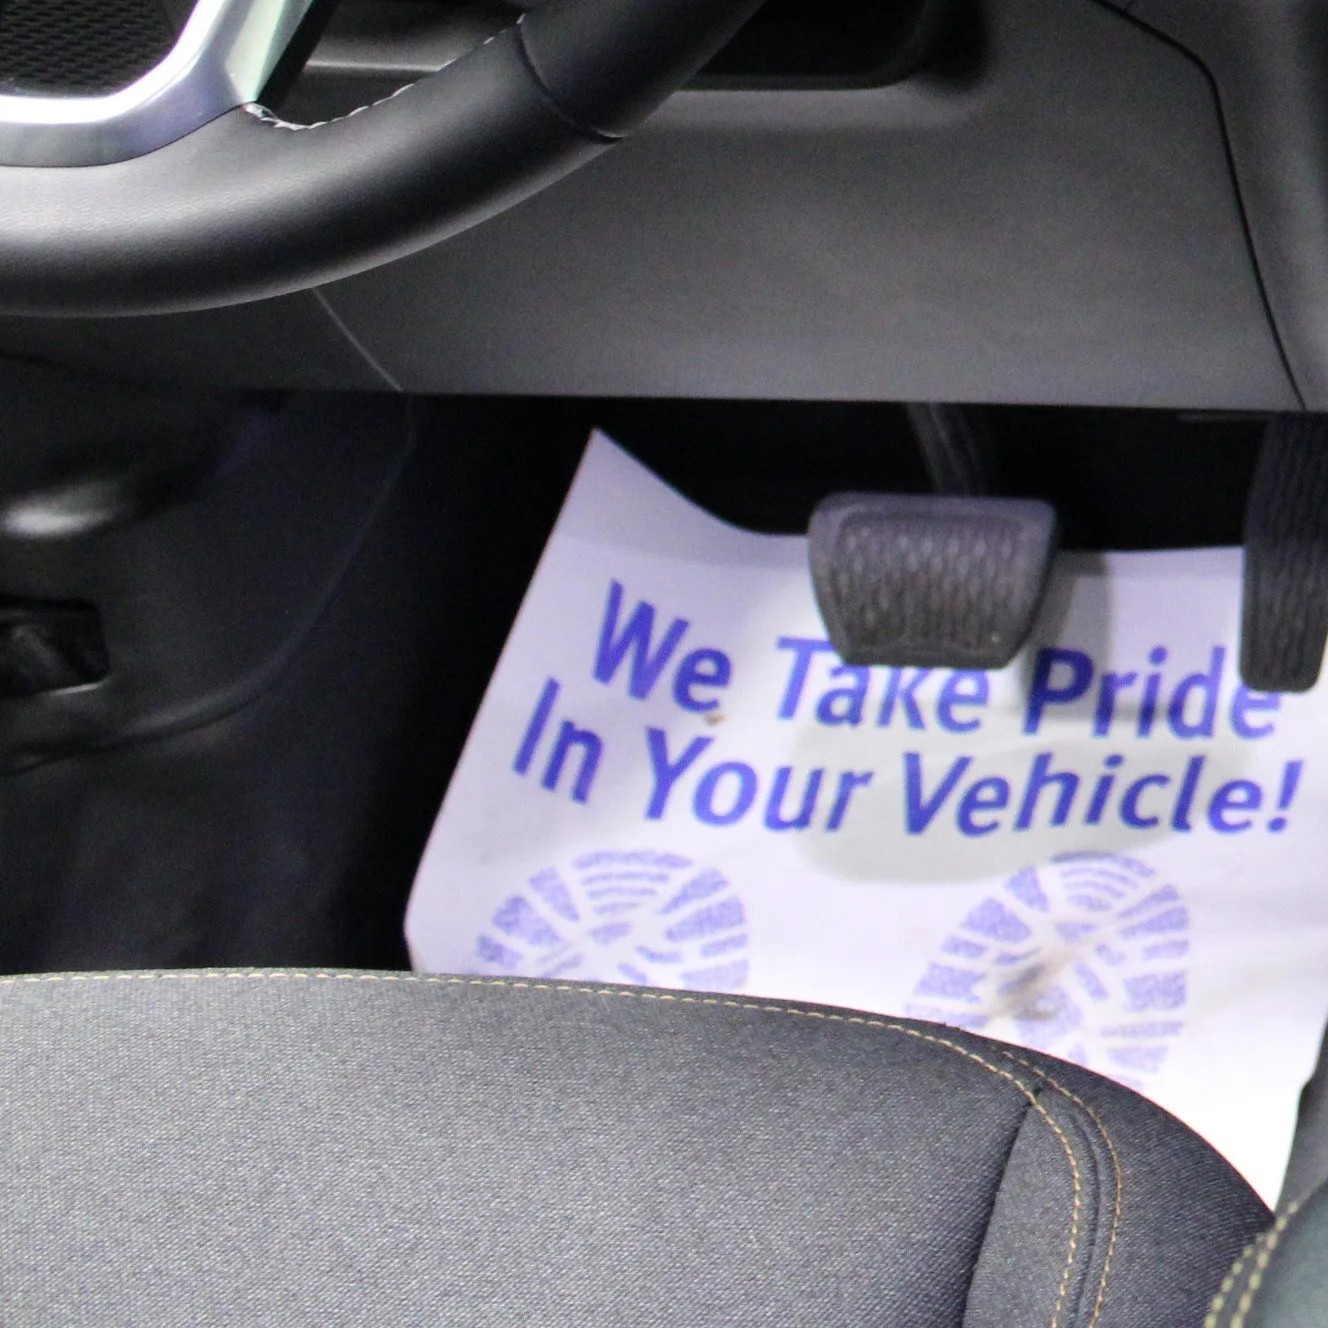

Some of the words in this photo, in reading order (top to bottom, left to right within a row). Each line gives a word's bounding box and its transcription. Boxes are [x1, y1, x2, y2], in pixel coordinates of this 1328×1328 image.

[589, 580, 731, 715] We
[776, 635, 991, 735] Take
[1021, 645, 1285, 741] Pride
[511, 677, 602, 805] In
[643, 727, 873, 833] Your
[902, 752, 1305, 838] Vehicle!
